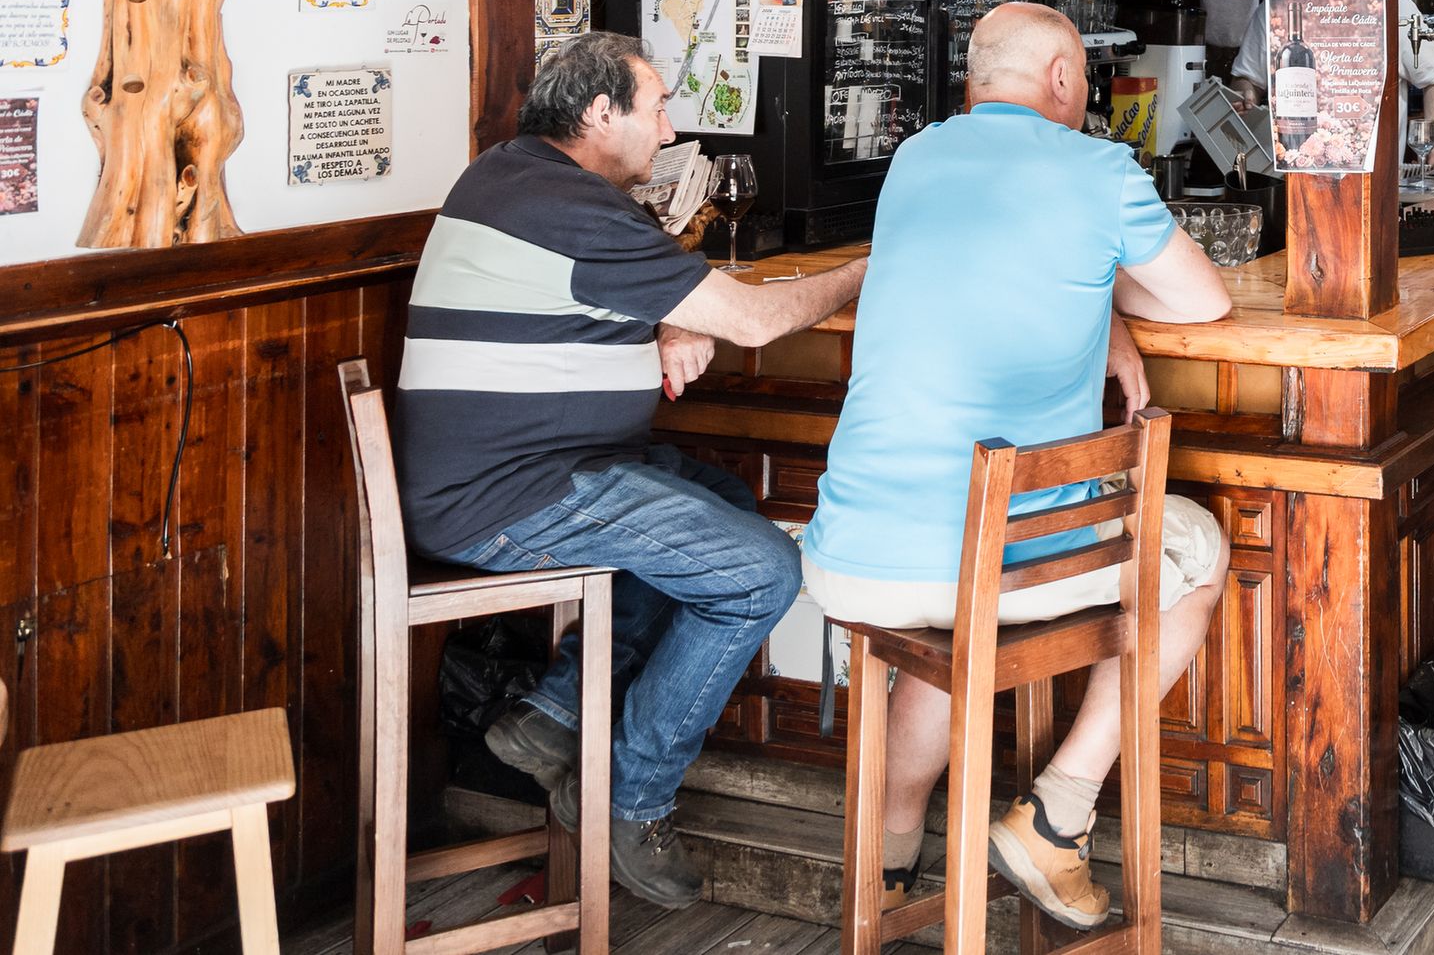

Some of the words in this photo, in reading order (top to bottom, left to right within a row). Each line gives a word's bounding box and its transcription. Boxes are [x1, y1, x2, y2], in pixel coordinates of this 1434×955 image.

[1320, 16, 1331, 24] del
[1331, 16, 1341, 24] sol
[1342, 16, 1350, 24] de
[1351, 14, 1378, 25] Cádiz
[1320, 50, 1352, 64] Oferta
[1352, 51, 1364, 63] de
[1329, 63, 1378, 76] Primavera
[336, 78, 361, 86] MADRE
[329, 88, 368, 96] OCASIONES
[1336, 102, 1361, 113] 30€
[307, 130, 359, 140] CONSECUENCIA
[316, 141, 357, 149] DESARROLLE
[293, 153, 323, 162] TRAUMA
[325, 150, 354, 159] INFANTIL
[356, 147, 390, 156] LLAMADO
[321, 160, 353, 170] RESPETO
[318, 171, 332, 179] LOS
[334, 167, 363, 177] DEMAS
